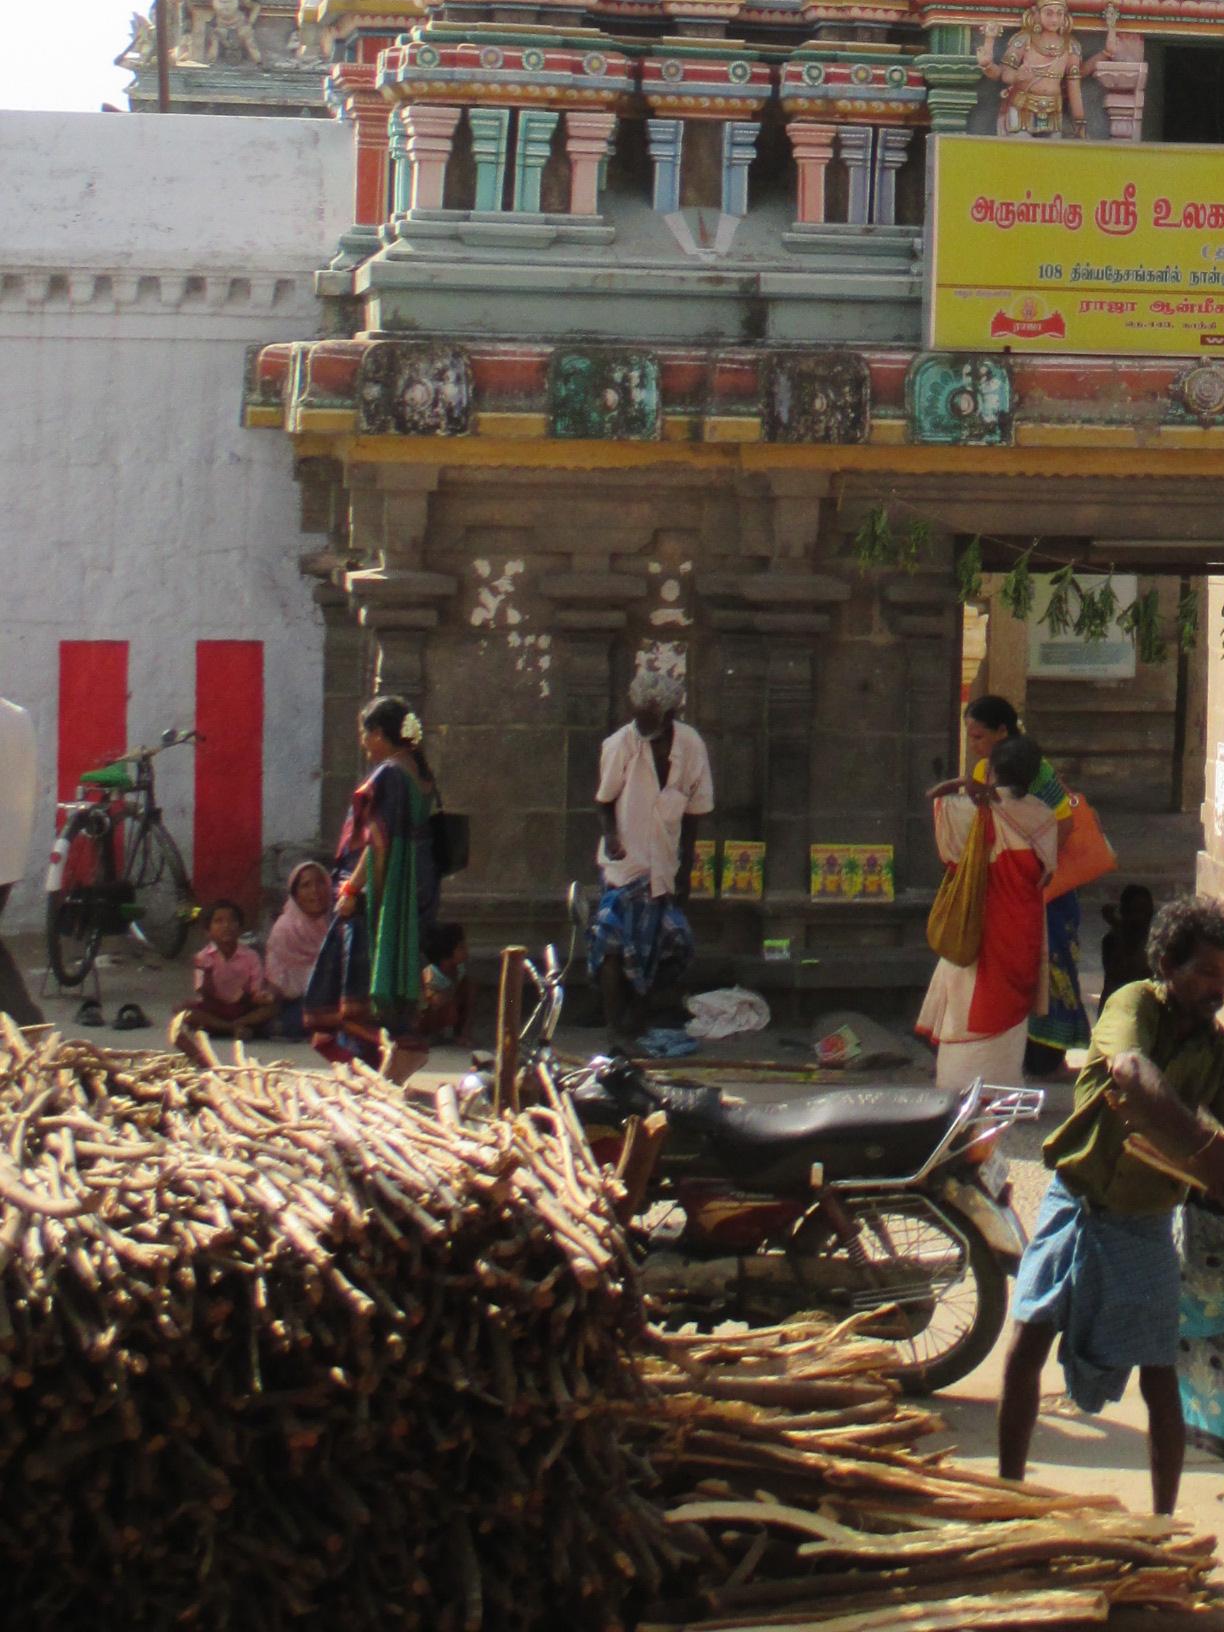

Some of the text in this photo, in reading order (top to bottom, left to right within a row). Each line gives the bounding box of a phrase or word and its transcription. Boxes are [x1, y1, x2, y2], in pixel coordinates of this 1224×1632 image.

[971, 190, 1083, 230] அருள்மிகு
[1038, 264, 1062, 280] 108
[1078, 299, 1137, 314] ராஜா
